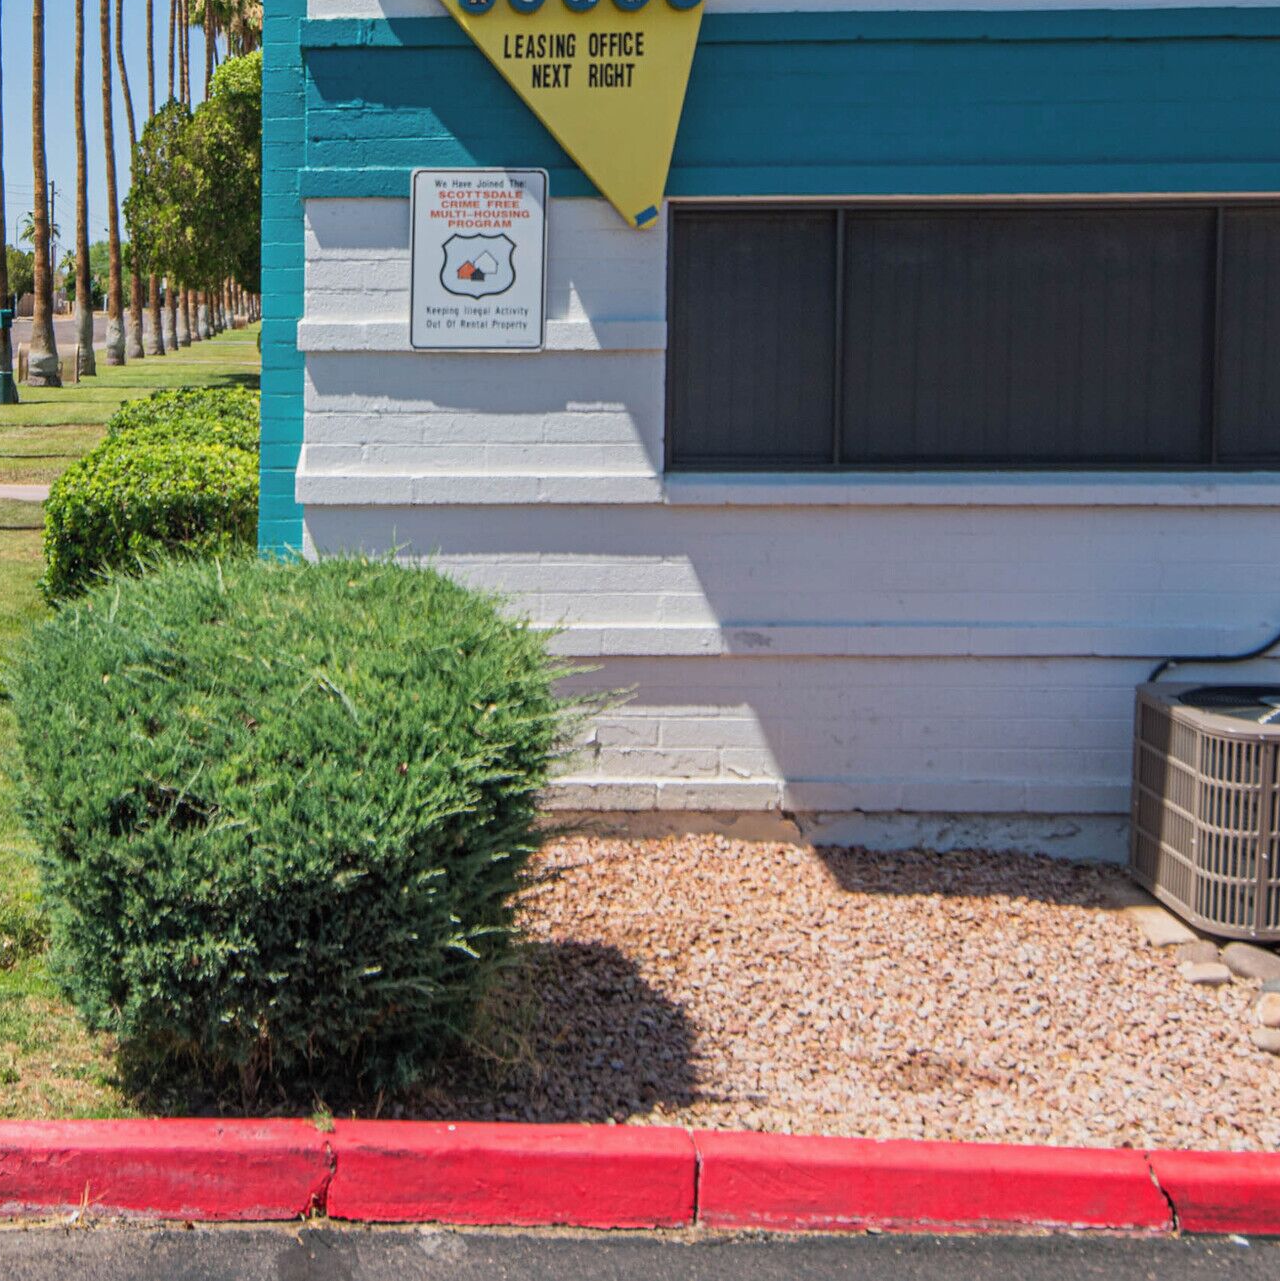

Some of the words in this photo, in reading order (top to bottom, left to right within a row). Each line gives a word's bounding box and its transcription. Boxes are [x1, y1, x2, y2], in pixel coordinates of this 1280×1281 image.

[503, 33, 577, 60] LEASING
[588, 31, 645, 58] OFFICE
[531, 64, 572, 89] NEXT
[588, 63, 636, 88] RIGHT
[435, 179, 448, 188] We
[452, 180, 472, 188] Have
[476, 179, 505, 188] Joined
[438, 190, 524, 199] SCOTTSDALE
[441, 200, 480, 209] CRIME
[487, 200, 520, 209] FREE
[430, 210, 530, 219] MULTI-HOUSING
[448, 219, 512, 228] PROGRAM
[426, 306, 459, 317] Keeping
[464, 306, 491, 317] Illegal
[495, 306, 529, 317] Activity
[426, 319, 441, 329] Out
[446, 319, 456, 329] Of
[460, 320, 488, 329] Rental
[492, 320, 528, 331] Property
